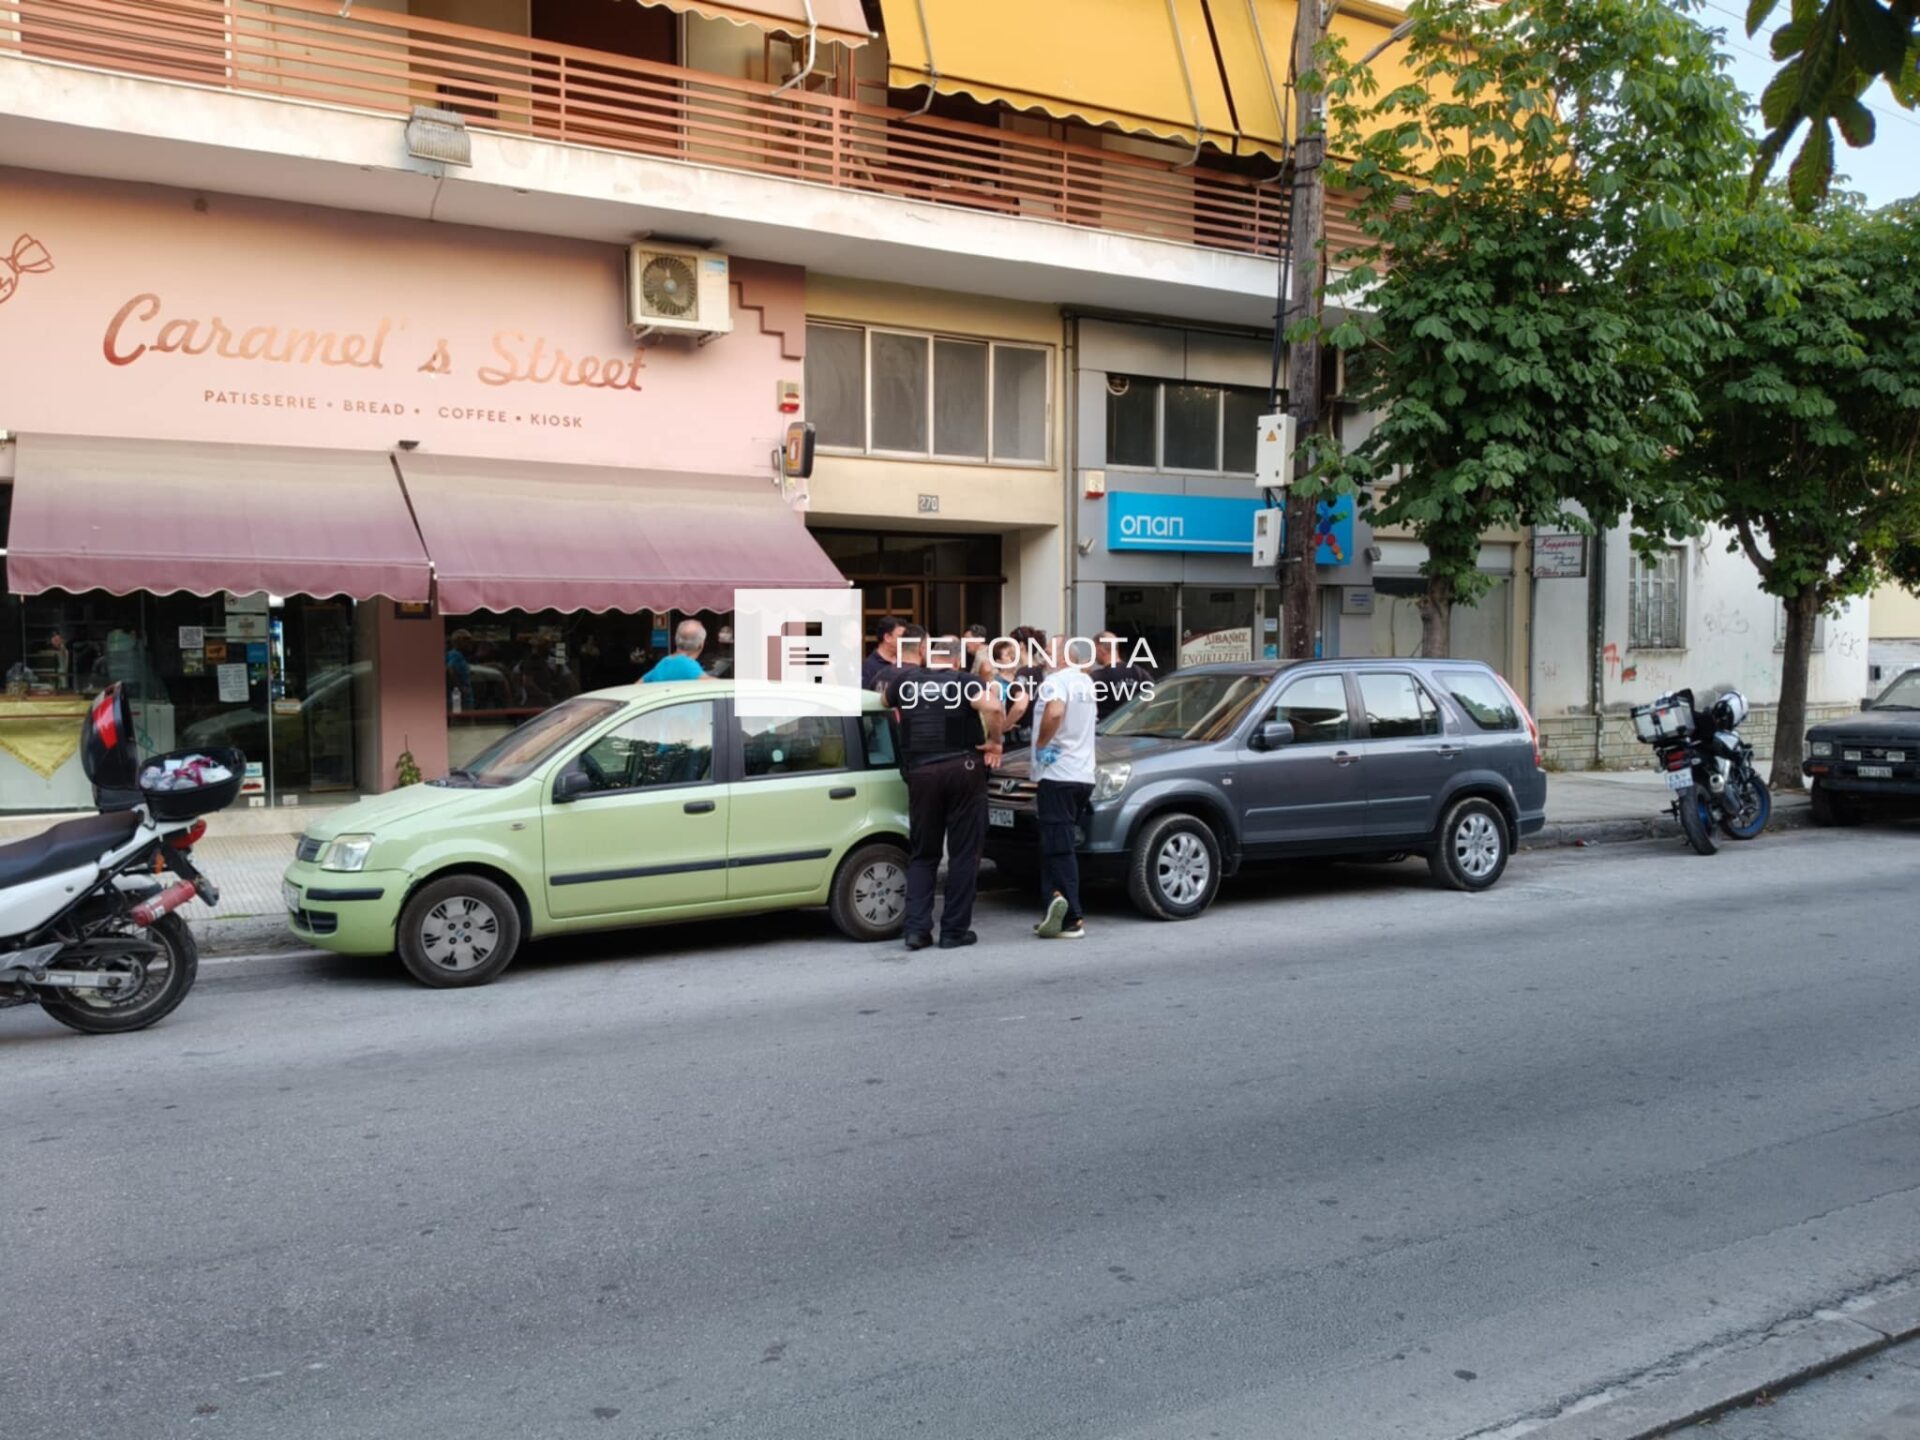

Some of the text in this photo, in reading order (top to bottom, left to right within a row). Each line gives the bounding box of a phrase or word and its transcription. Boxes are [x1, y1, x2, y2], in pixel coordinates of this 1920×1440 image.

[477, 327, 647, 392] Street
[204, 389, 582, 428] PATISSERIE BREAD COFFEE KIOSK
[919, 495, 938, 511] 270
